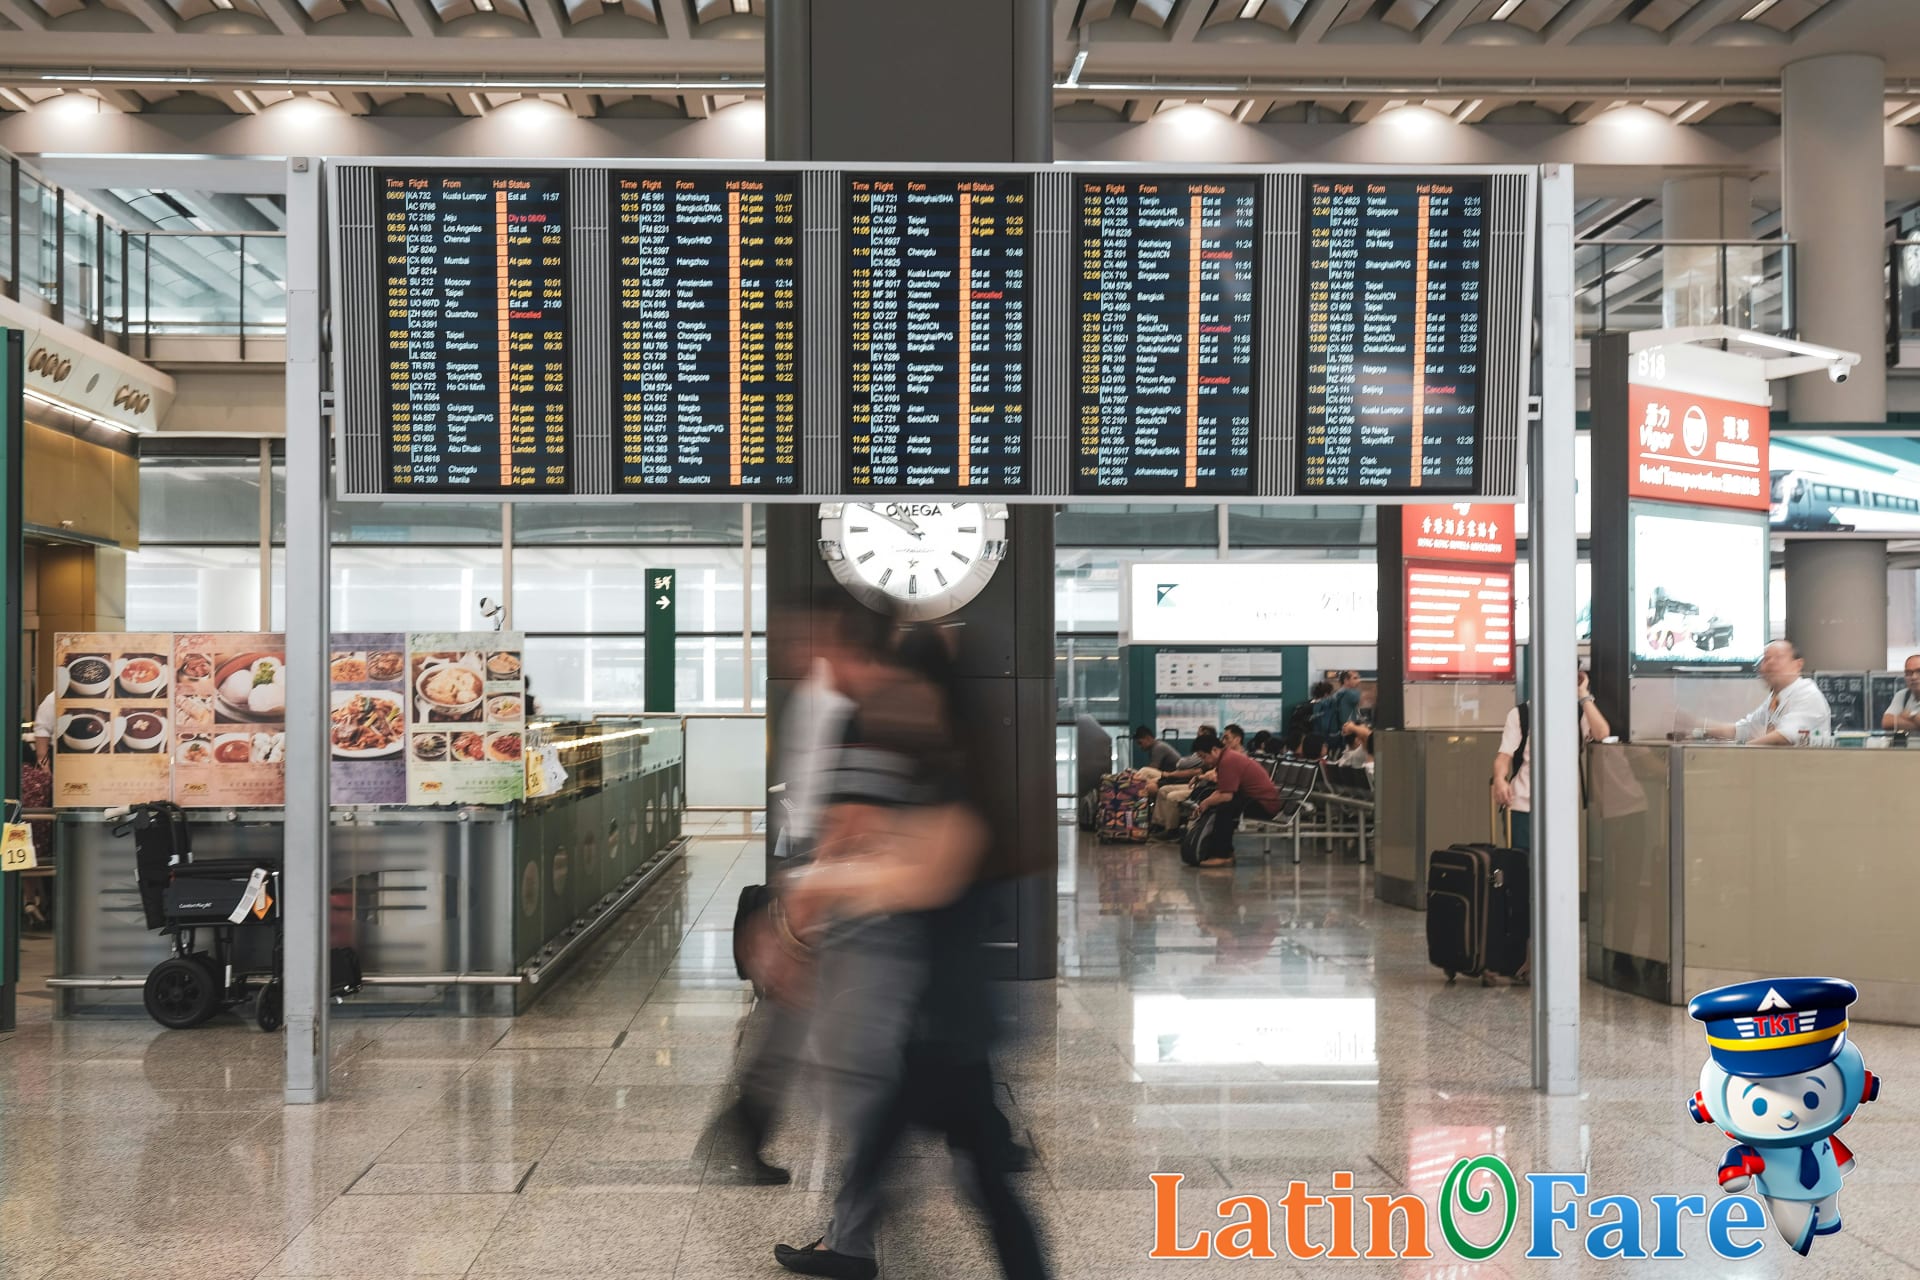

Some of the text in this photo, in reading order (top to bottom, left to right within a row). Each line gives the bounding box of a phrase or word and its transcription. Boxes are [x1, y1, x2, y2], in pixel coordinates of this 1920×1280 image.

[386, 178, 531, 190] Time Flight From Hall Status
[620, 180, 763, 191] Time Flight From Hall Status
[852, 181, 994, 192] Time Flight From Hall Status
[1084, 184, 1225, 195] Time Flight From Hall Status
[1312, 184, 1453, 195] Time Flight From Hall Status
[443, 192, 463, 200] Kuala
[464, 192, 487, 202] Lumpur
[676, 193, 710, 203] Kaohsiung
[750, 194, 763, 203] gate
[907, 194, 954, 204] Shanghai/SHA
[1139, 196, 1160, 207] Tianjin
[676, 203, 721, 214] Bangkok/DMK
[1138, 207, 1178, 216] London/LHR
[1366, 207, 1399, 218] Singapore
[443, 213, 457, 223] Jeju
[676, 214, 723, 224] Shanghai/PVG
[456, 224, 482, 234] Angeles
[907, 226, 929, 237] Beijing
[443, 234, 471, 243] Chennai
[518, 236, 532, 245] gate
[676, 236, 712, 246] Tokyo/HND
[1138, 239, 1171, 250] Kaohsiung
[907, 247, 936, 258] Chengdu
[1201, 251, 1233, 259] Cancelled
[444, 256, 470, 265] Mumbai
[676, 257, 709, 267] Hangzhou
[444, 278, 471, 286] Moscow
[677, 279, 713, 287] Amsterdam
[907, 279, 940, 288] Quanzhou
[1365, 281, 1384, 291] Taipei
[445, 288, 464, 298] Taipei
[907, 290, 1003, 299] Xiamen Cancelled
[677, 300, 705, 310] Bangkok
[907, 301, 940, 311] Singapore
[445, 310, 542, 319] Quanzhou Cancelled
[677, 321, 706, 331] Chengdu
[677, 331, 712, 342] Chongqing
[446, 341, 479, 351] Bengaluru
[677, 342, 702, 352] Nanjing
[677, 352, 696, 361] Dubai
[446, 362, 479, 372] Singapore
[678, 362, 697, 372] Taipei
[907, 363, 944, 373] Guangzhou
[1638, 349, 1666, 381] B18
[678, 373, 710, 383] Singapore
[1136, 375, 1230, 384] Phnom Penh Cancelled
[447, 403, 474, 413] Guiyang
[971, 405, 994, 413] Landed
[1362, 406, 1380, 414] Kuala
[1380, 406, 1405, 415] Lumpur
[447, 414, 494, 423] Shanghai/PVG
[907, 435, 931, 444] Jakarta
[462, 444, 481, 453] Dhabi
[512, 445, 536, 453] Landed
[907, 445, 932, 455] Penang
[448, 465, 477, 475] Chengdu
[522, 466, 535, 475] gate
[907, 466, 950, 474] Osaka/Kansai
[449, 475, 470, 484] Manila
[678, 475, 711, 484] Seoul/ICN
[886, 504, 942, 517] OMEGA
[7, 849, 26, 864] 19
